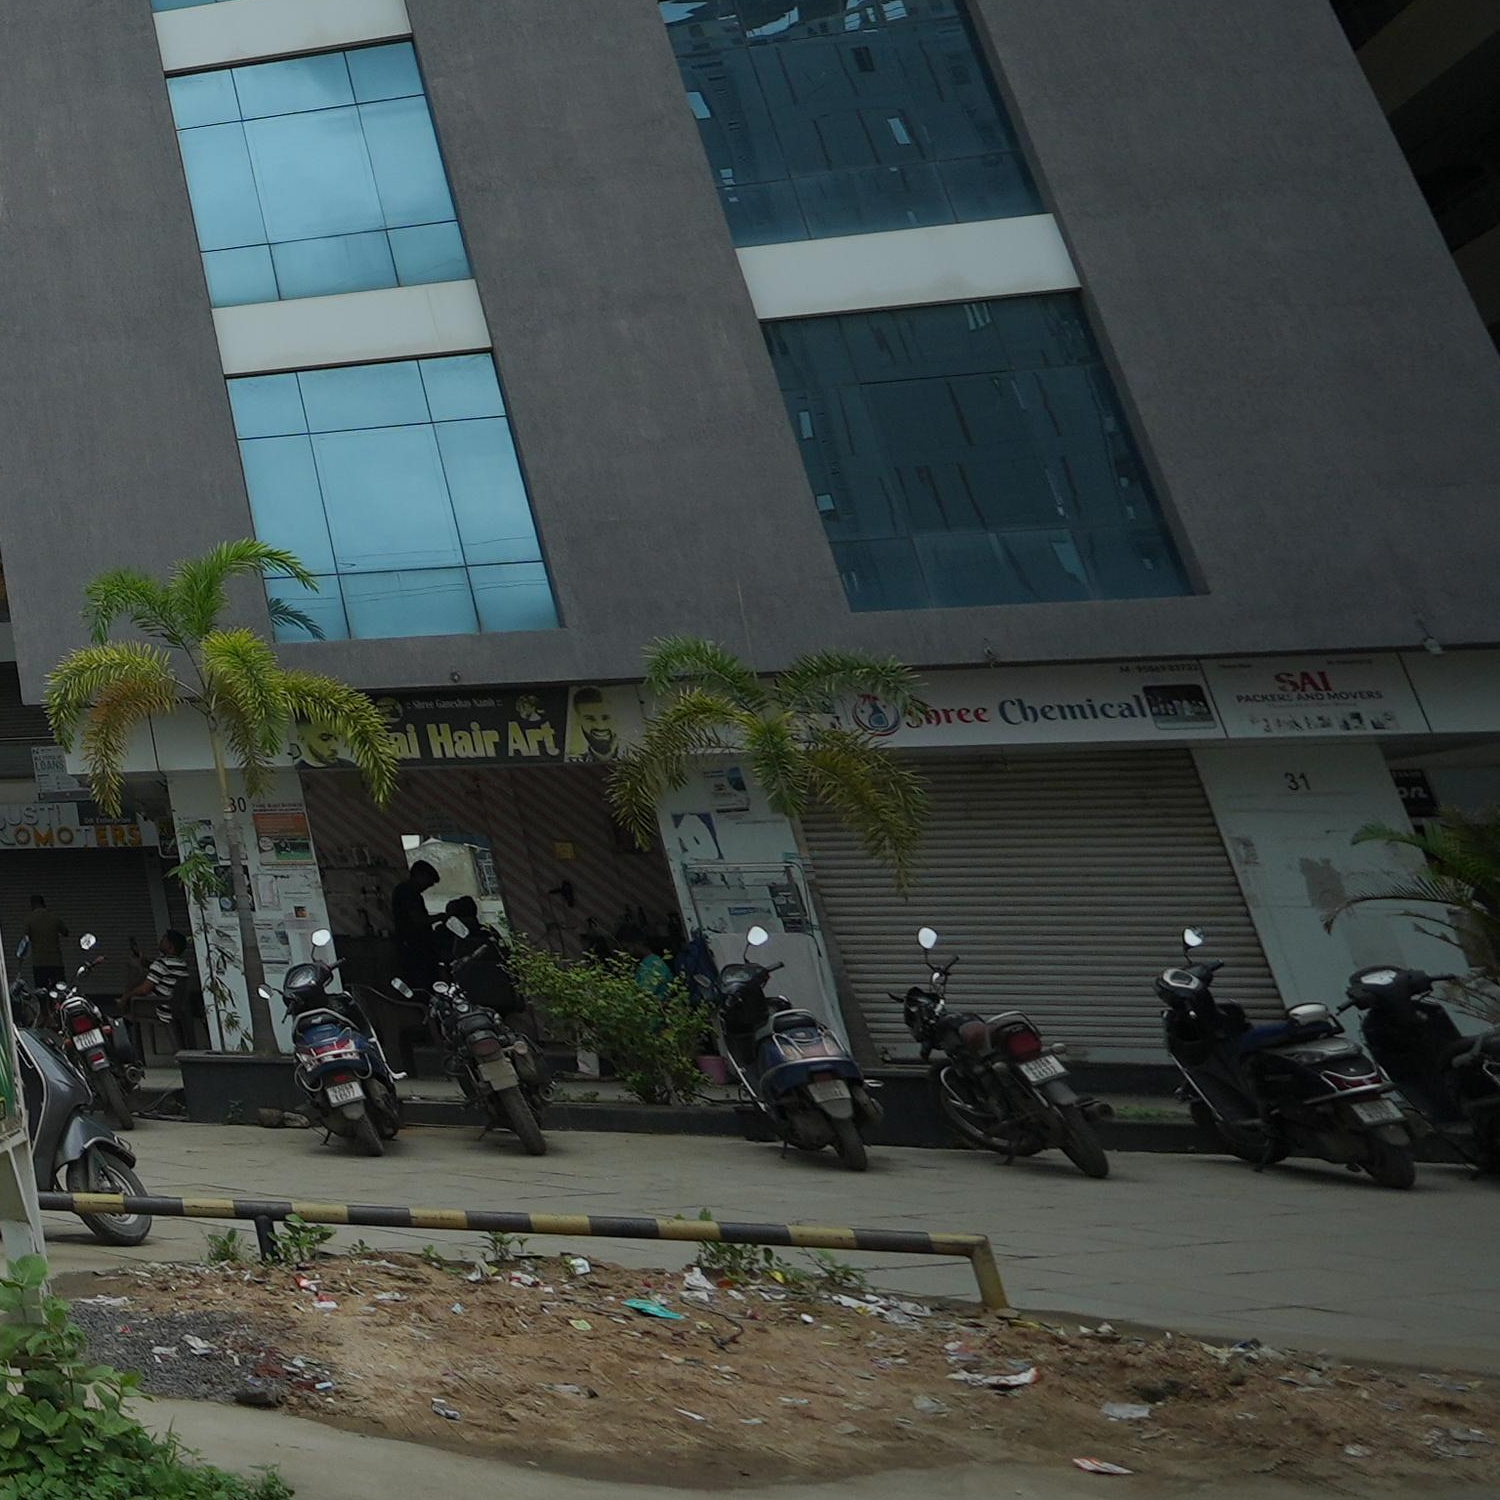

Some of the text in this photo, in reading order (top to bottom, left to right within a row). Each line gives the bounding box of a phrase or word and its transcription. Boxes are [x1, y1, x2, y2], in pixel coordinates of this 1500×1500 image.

[1272, 671, 1334, 693] SAI
[1296, 691, 1325, 701] AND
[1327, 690, 1384, 700] MOVERS
[998, 693, 1147, 726] Chemical
[426, 720, 561, 759] Hair Art
[1284, 771, 1311, 791] 31
